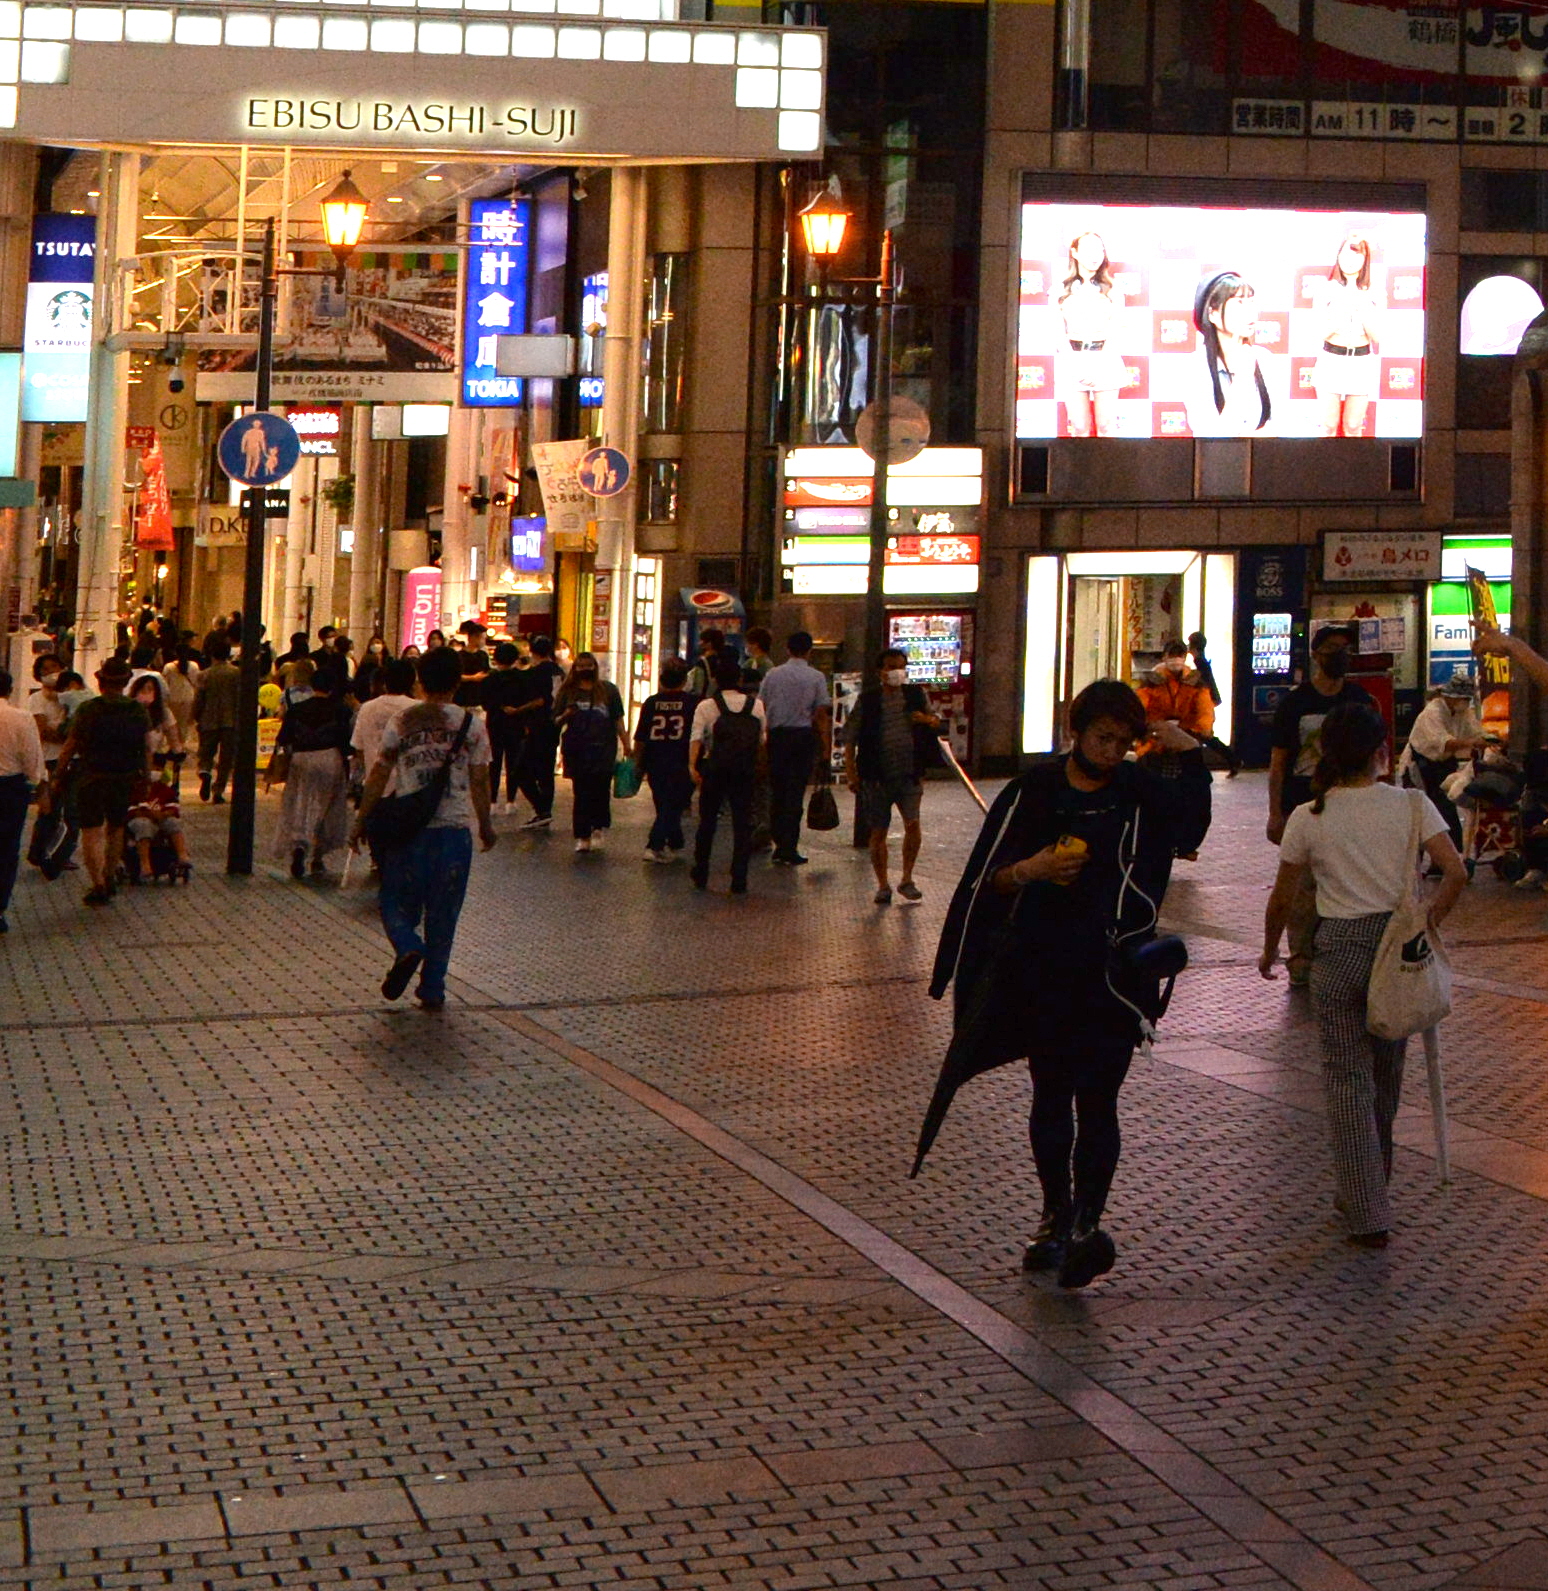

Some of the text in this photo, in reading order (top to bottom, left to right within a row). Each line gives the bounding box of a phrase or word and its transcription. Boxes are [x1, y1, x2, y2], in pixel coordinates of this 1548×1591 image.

[246, 98, 578, 143] EBISU BASHI-SUJI
[1235, 104, 1301, 130] 営業時間
[1315, 114, 1343, 130] AM
[36, 241, 96, 257] TSUTA
[358, 374, 385, 386] ミナミ
[467, 379, 520, 398] TOKIA
[786, 479, 797, 493] 3
[786, 509, 794, 520] 2
[888, 508, 899, 520] 6
[1382, 547, 1430, 565] 鳥メロ
[413, 584, 433, 616] UQ
[1255, 587, 1284, 599] BOSS
[650, 715, 684, 740] 23
